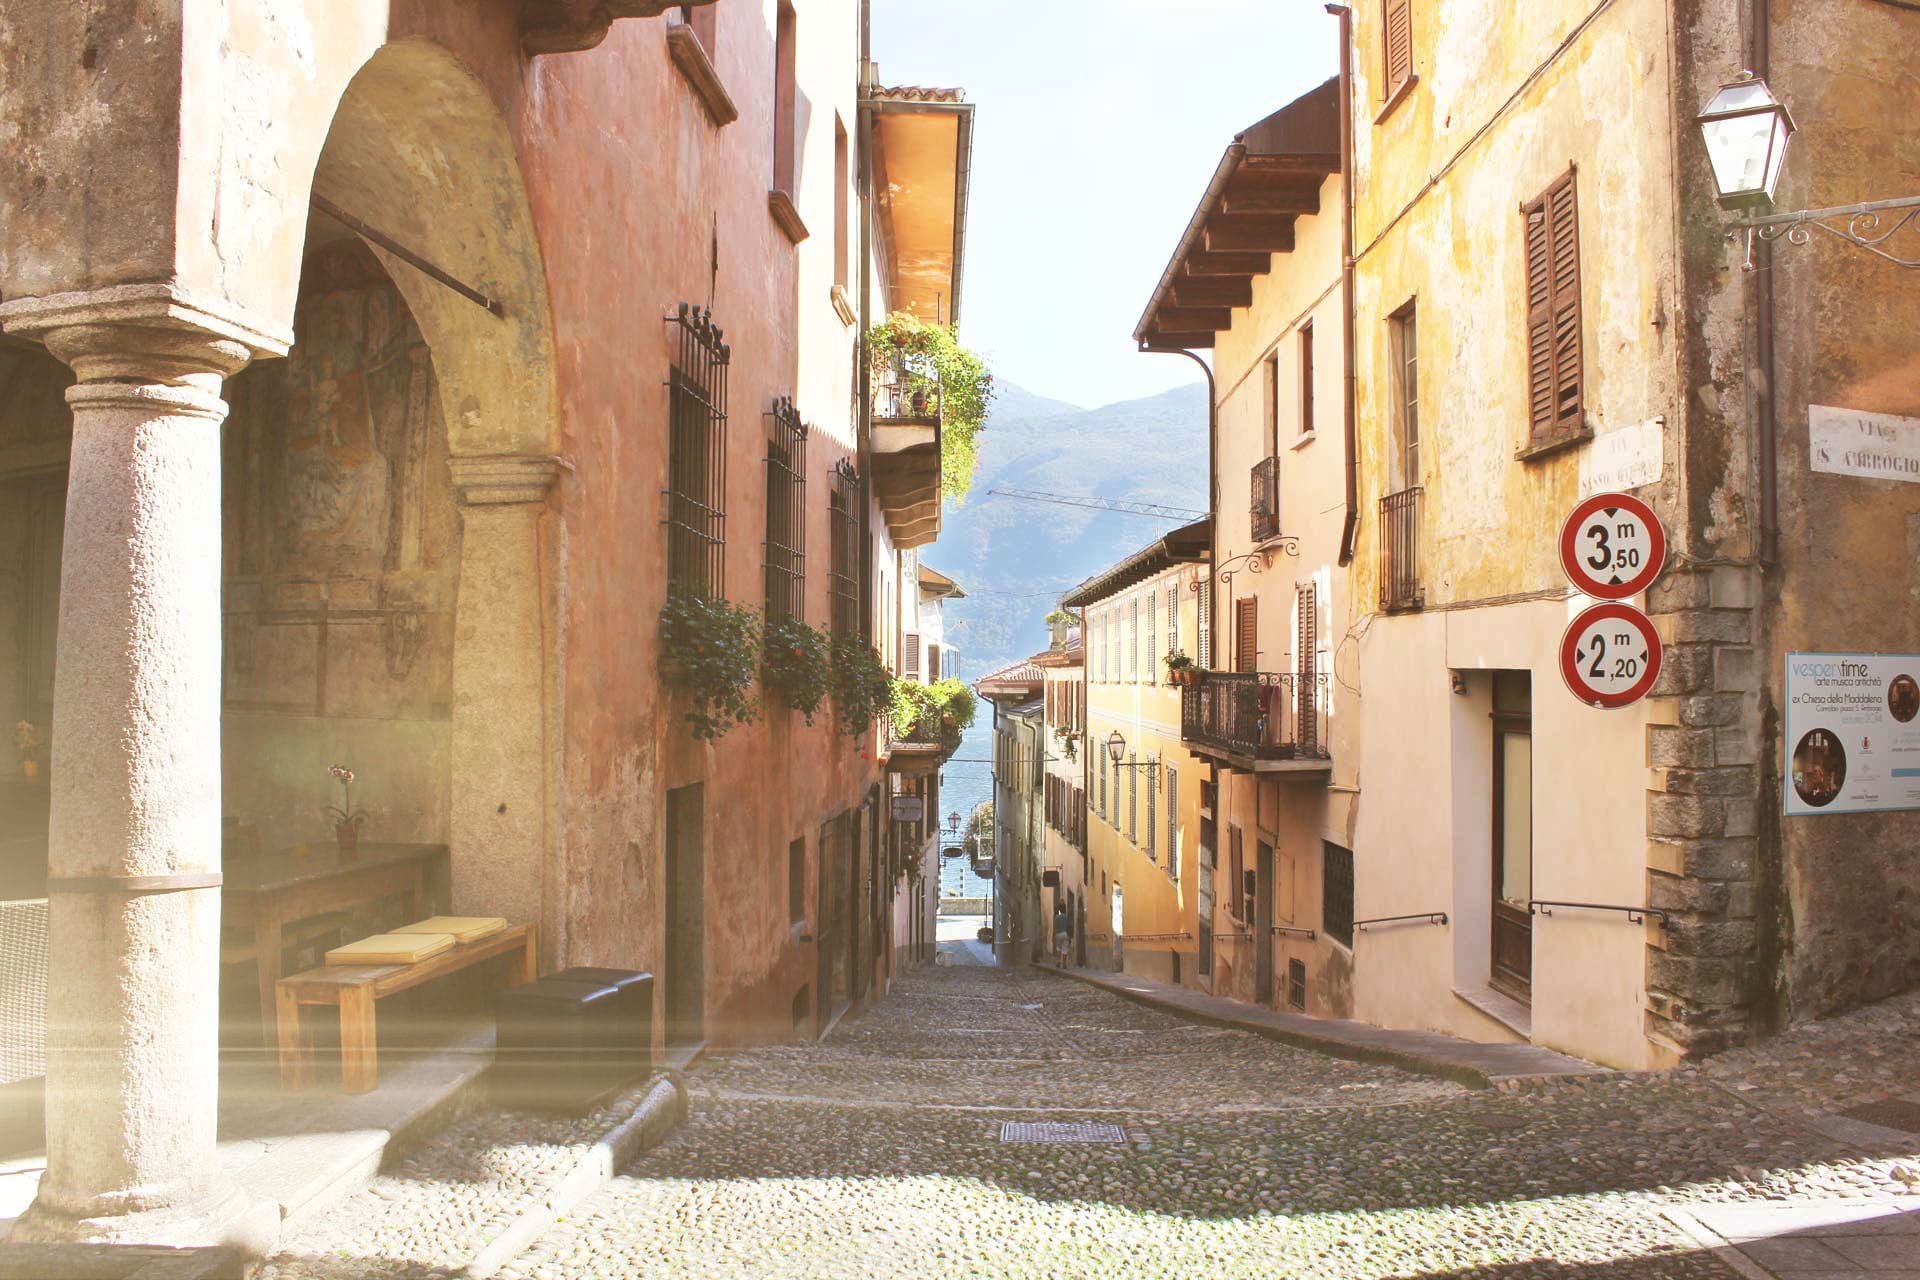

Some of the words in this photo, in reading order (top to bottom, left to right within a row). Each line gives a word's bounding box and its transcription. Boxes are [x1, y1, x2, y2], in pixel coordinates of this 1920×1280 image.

[1844, 450, 1919, 473] AMBROGIO
[1831, 678, 1853, 686] musica
[1801, 693, 1826, 703] Chiesa
[1844, 692, 1882, 703] Maddalena
